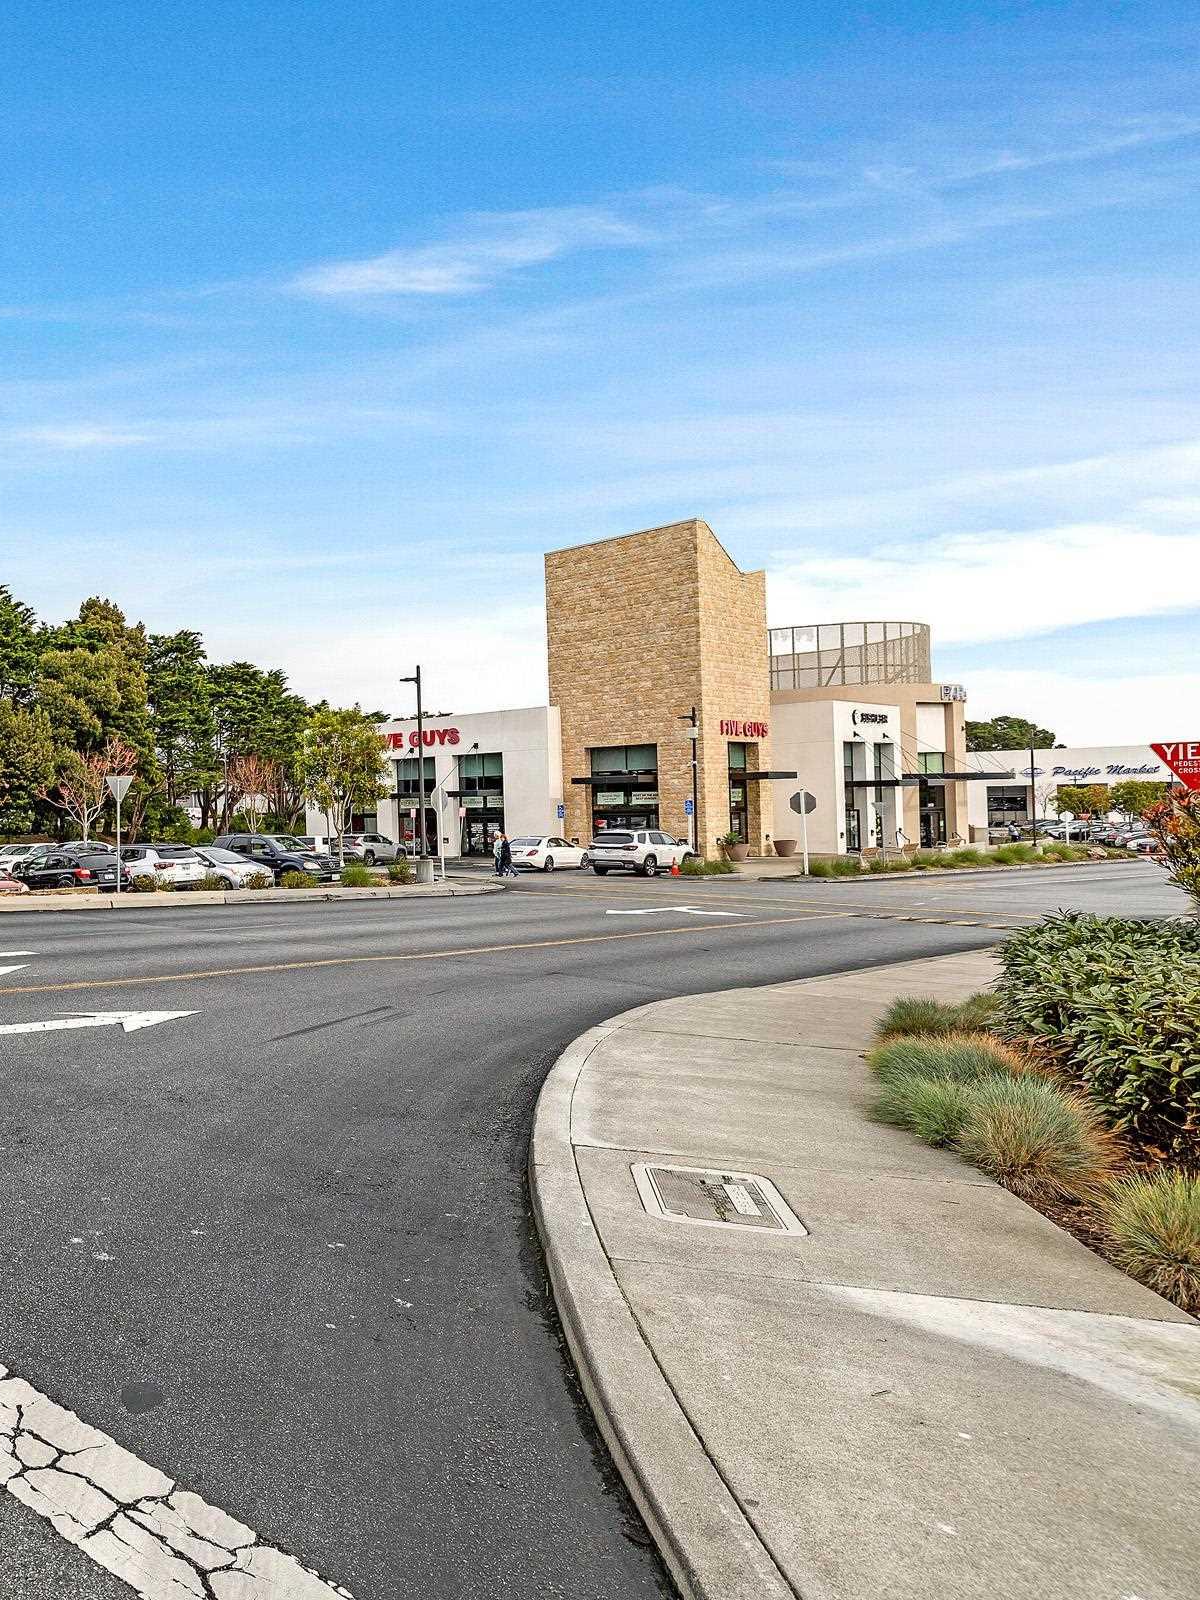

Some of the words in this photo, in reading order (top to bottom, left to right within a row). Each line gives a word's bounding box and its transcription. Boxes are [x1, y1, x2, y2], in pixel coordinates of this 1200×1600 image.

[409, 727, 460, 747] GUYS
[743, 721, 768, 738] GUYS
[1052, 766, 1101, 778] Pacific
[1106, 764, 1160, 775] Market
